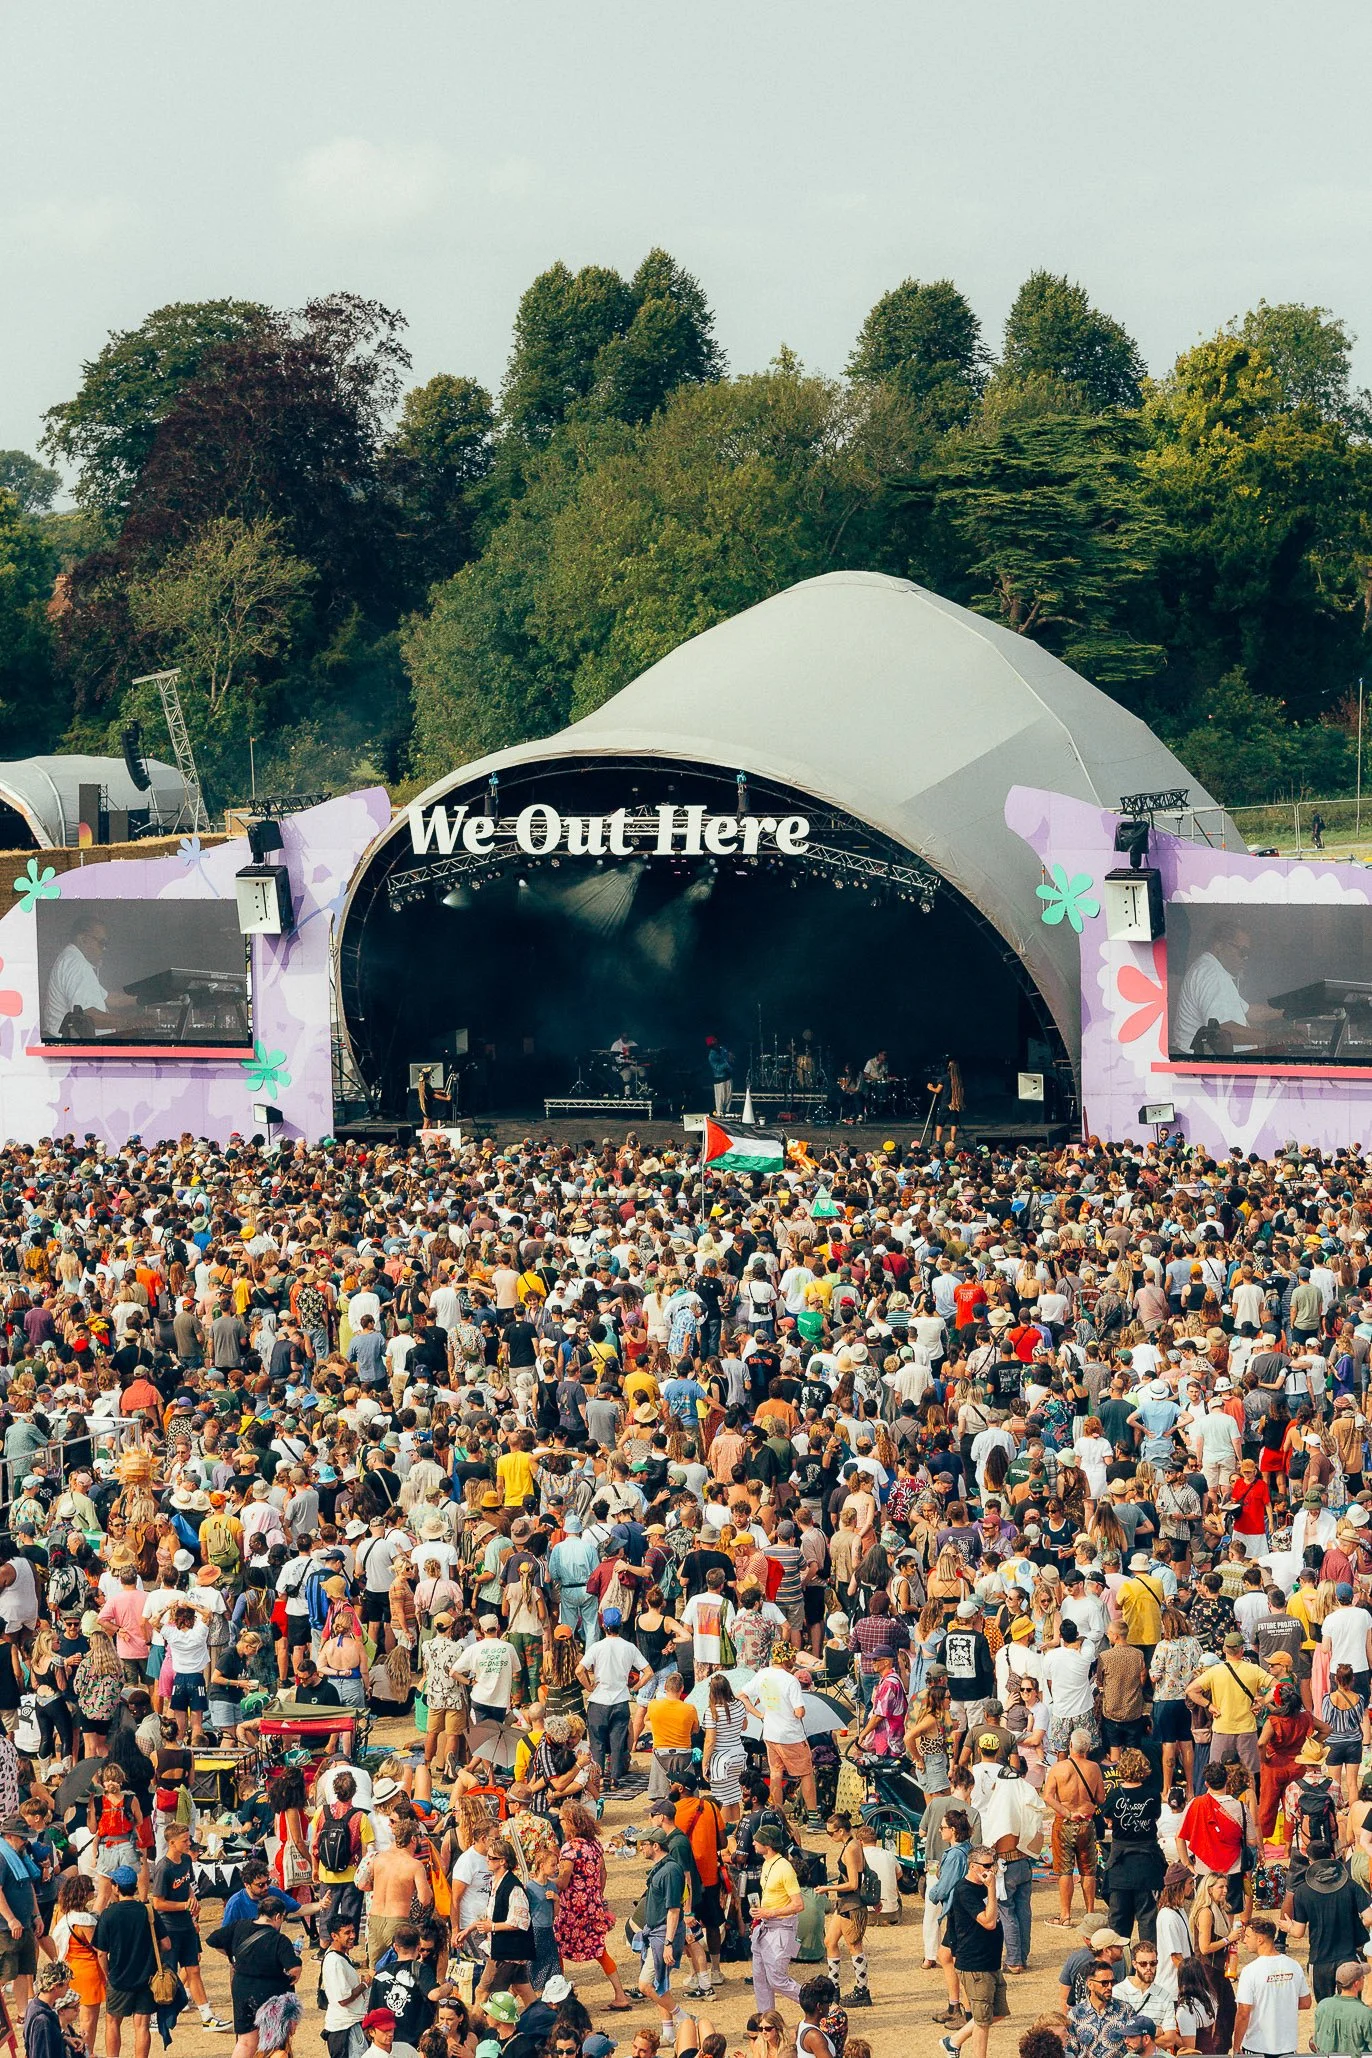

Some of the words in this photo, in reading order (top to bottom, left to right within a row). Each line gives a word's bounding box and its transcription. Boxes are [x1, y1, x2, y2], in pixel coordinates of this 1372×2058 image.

[407, 806, 495, 854] We
[516, 804, 634, 855] Out
[652, 805, 810, 855] Here
[1104, 1770, 1121, 1778] JAME
